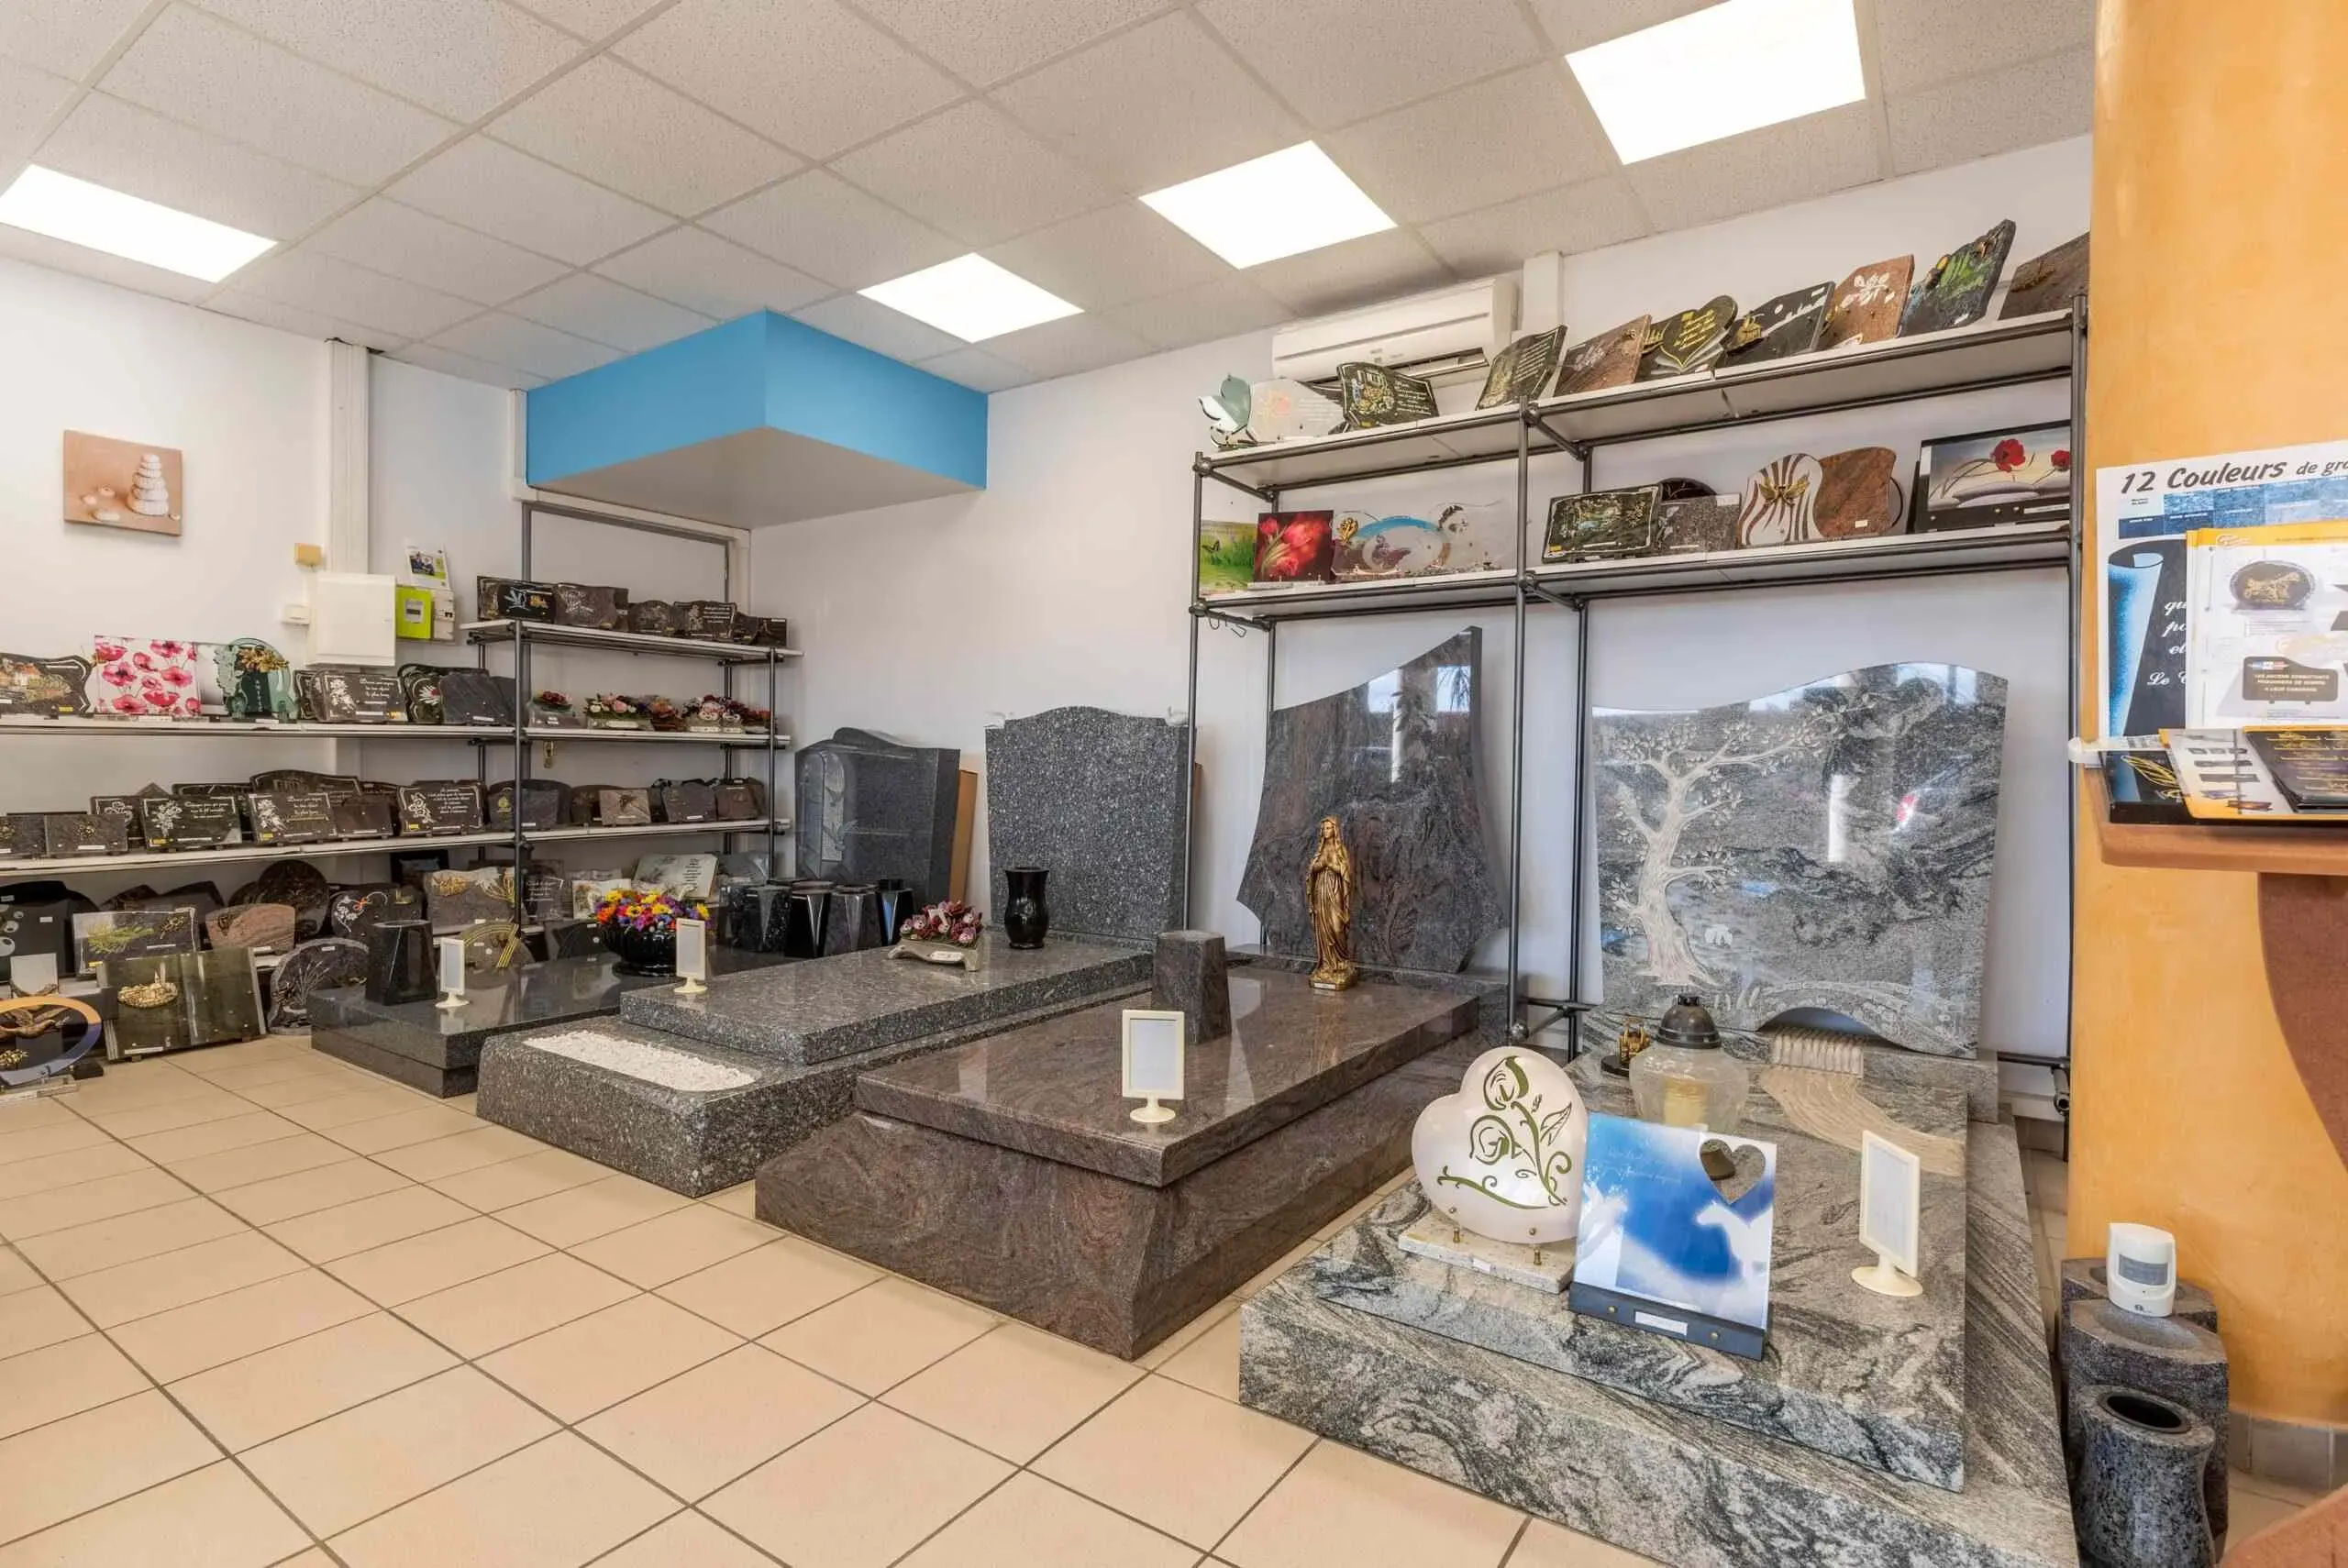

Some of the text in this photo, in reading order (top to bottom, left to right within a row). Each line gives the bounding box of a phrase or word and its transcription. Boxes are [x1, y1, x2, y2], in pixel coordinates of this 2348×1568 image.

[2121, 470, 2156, 493] 12
[2166, 461, 2287, 489] Couleurs
[2296, 461, 2318, 475] de
